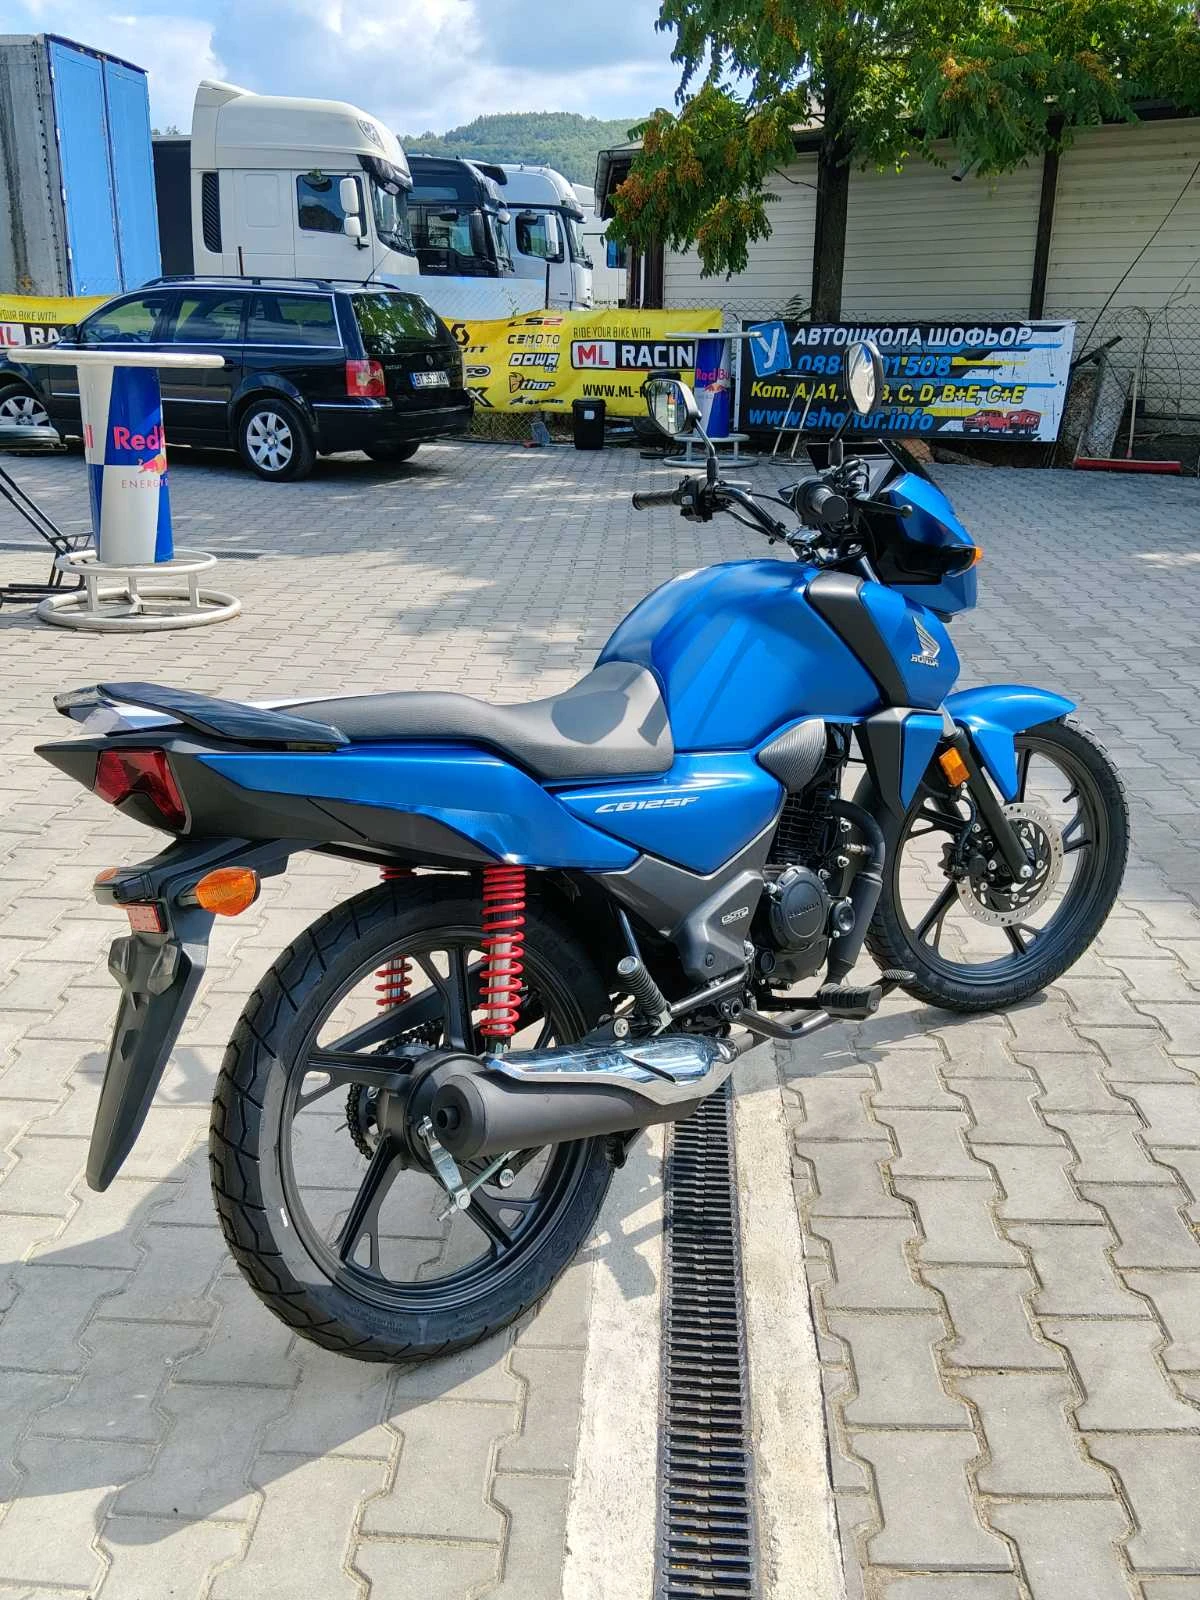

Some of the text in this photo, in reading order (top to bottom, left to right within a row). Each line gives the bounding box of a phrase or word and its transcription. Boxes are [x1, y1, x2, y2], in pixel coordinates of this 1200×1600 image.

[38, 312, 57, 321] WITH
[573, 327, 651, 338] RIDE YOUR BIKE WITH
[792, 327, 1033, 347] АВТОШКОЛА ШОФЬОР
[577, 344, 694, 367] ML RACIN
[113, 424, 159, 450] Red
[594, 796, 701, 814] CB125F
